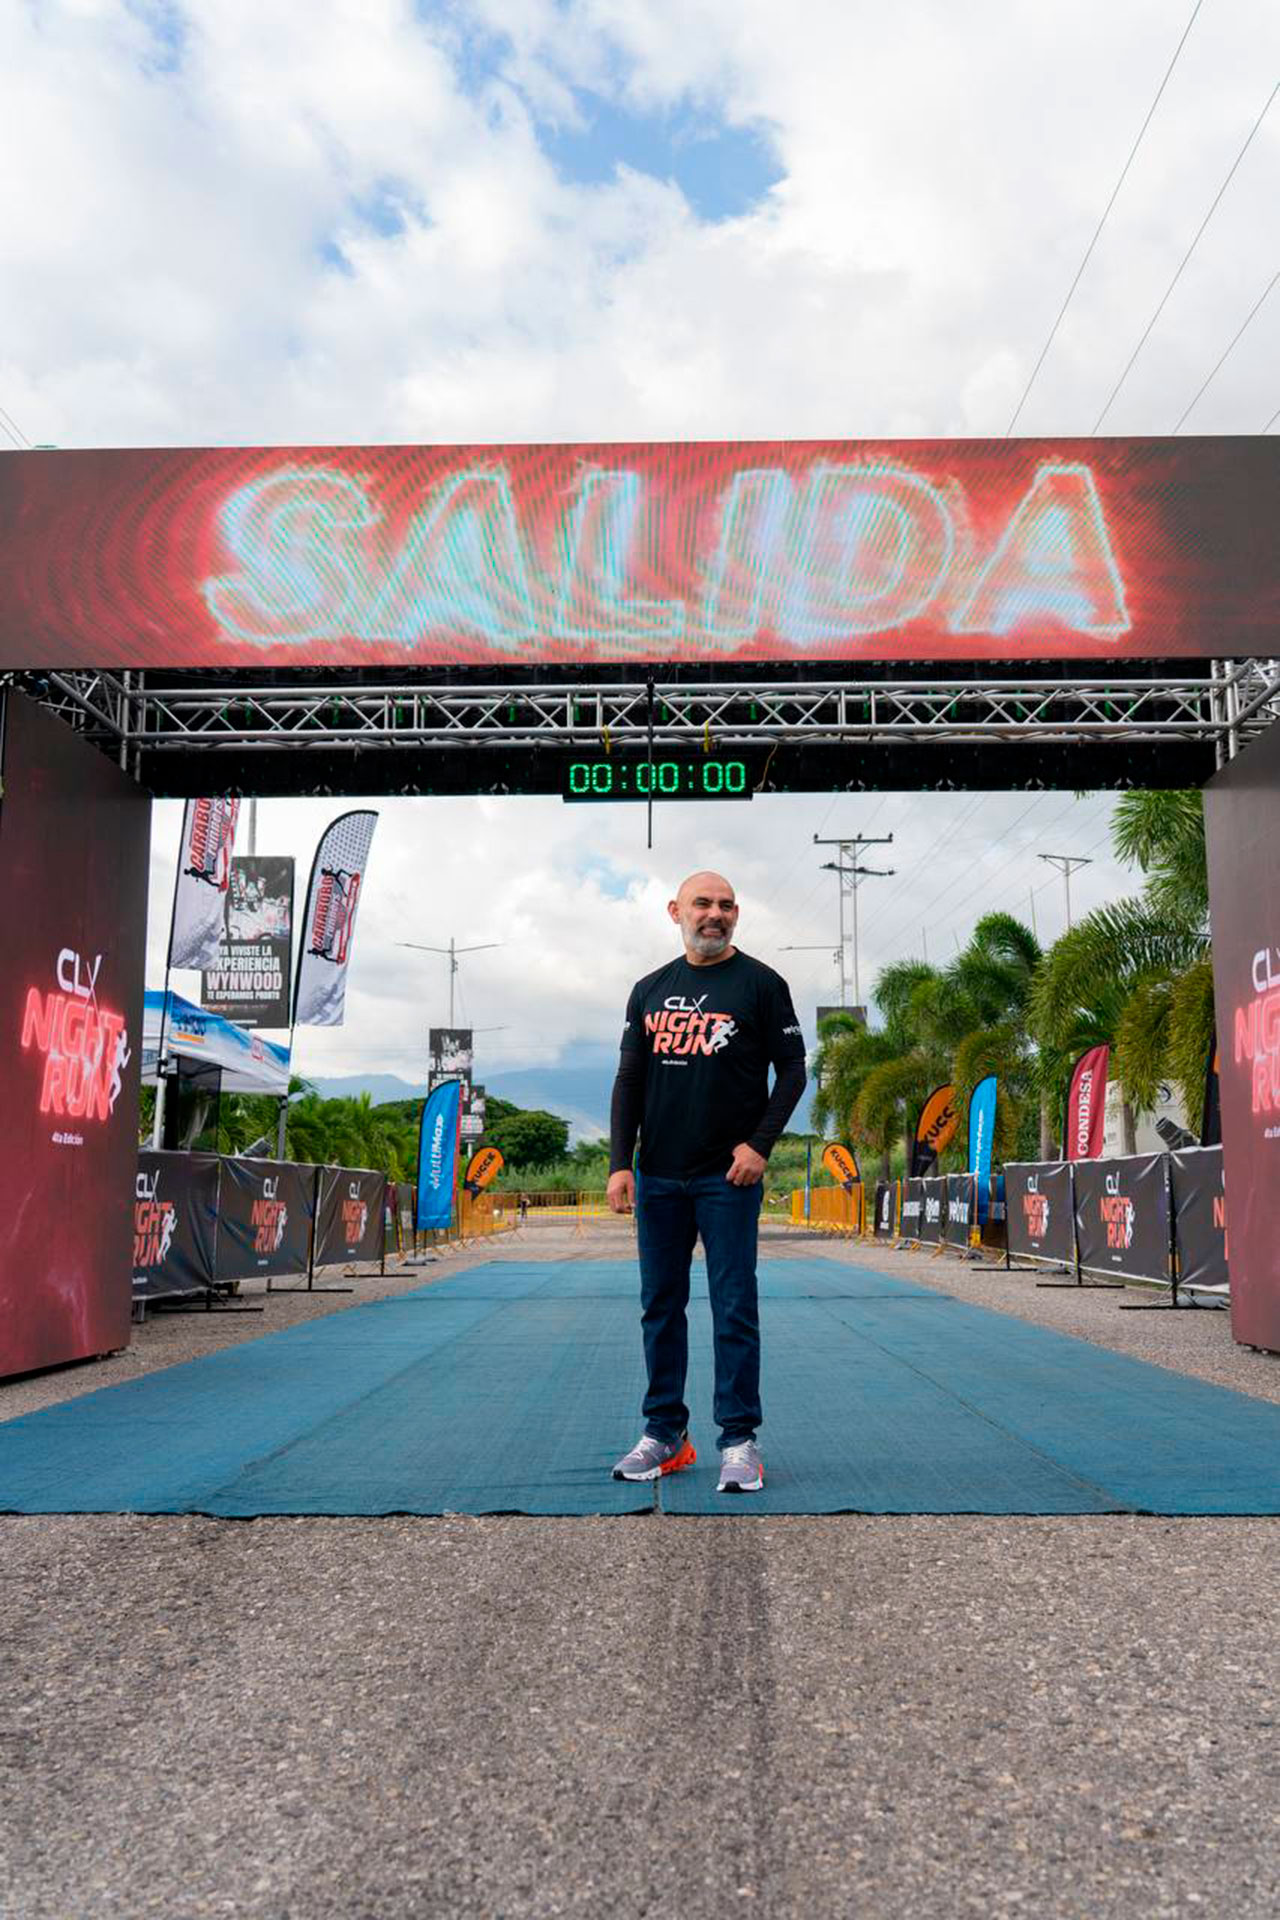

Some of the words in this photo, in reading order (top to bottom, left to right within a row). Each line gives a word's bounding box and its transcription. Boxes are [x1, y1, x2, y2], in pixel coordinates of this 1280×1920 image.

[202, 459, 1133, 652] SALIDA
[569, 762, 746, 793] 00:00:00
[206, 971, 282, 990] WYNWOOD
[20, 986, 126, 1068] NIGHT
[645, 1010, 733, 1035] NIGHT
[653, 1032, 717, 1056] RUN
[39, 1053, 112, 1121] RUN
[1077, 1069, 1093, 1156] CONDESA
[252, 1200, 286, 1226] NIGHT
[1101, 1196, 1130, 1222] NIGHT
[256, 1226, 277, 1252] RUN
[1107, 1222, 1129, 1248] RUN
